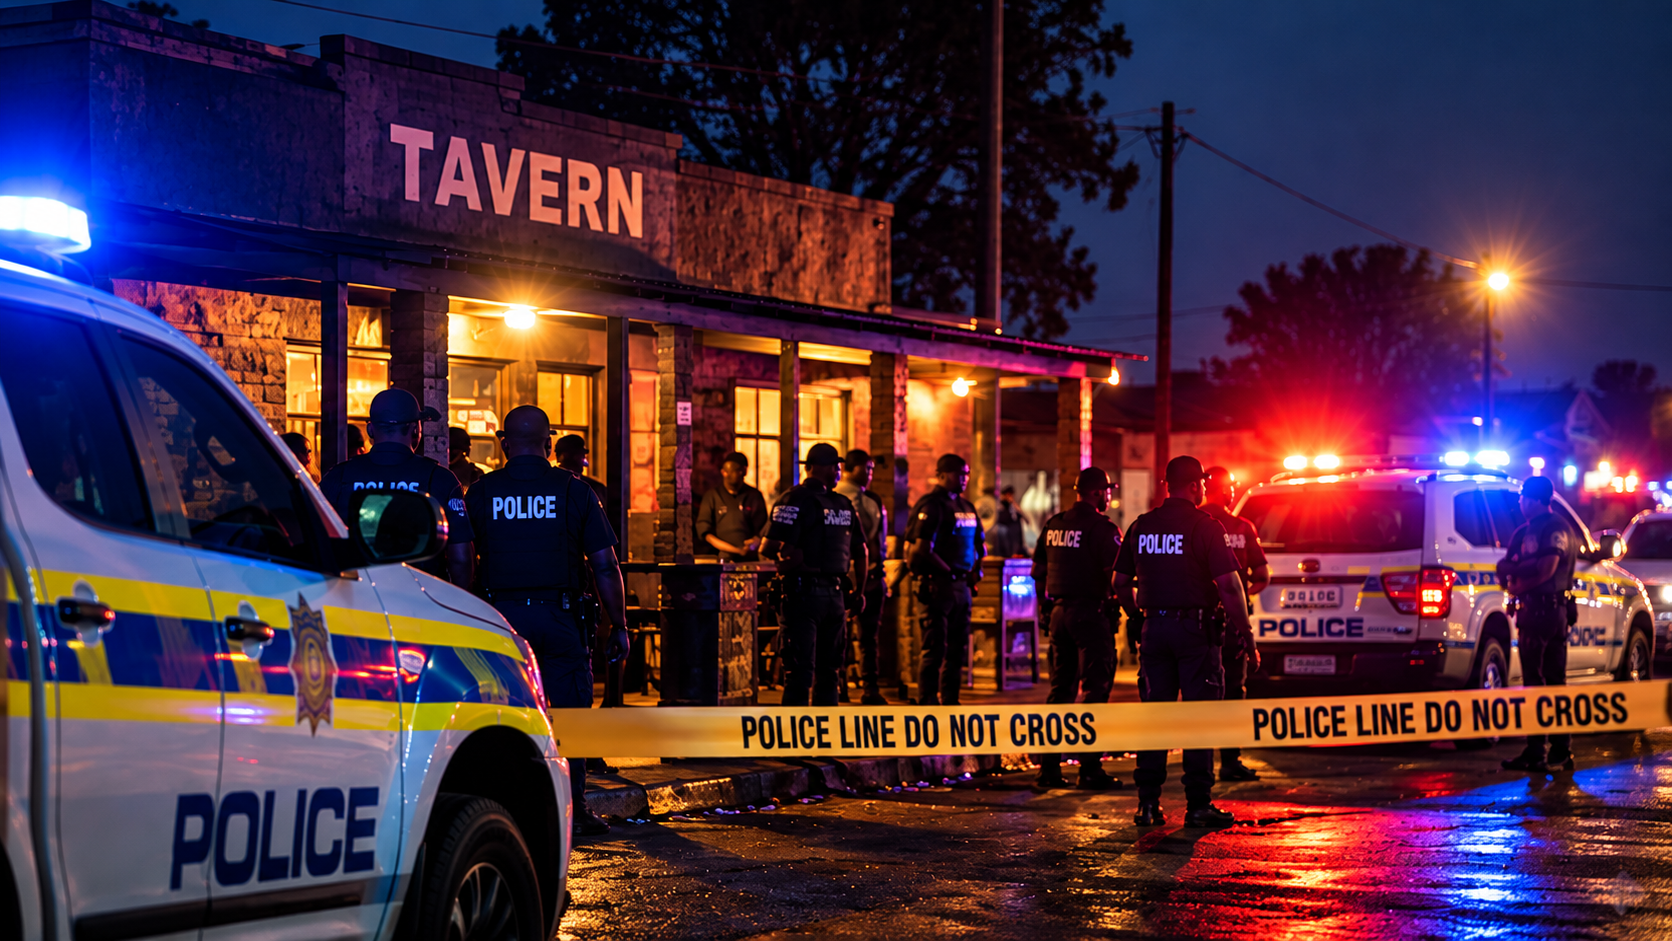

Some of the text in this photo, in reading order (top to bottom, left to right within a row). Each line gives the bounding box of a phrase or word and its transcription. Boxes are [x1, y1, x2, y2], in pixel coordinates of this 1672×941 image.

[390, 123, 643, 239] TAVERN
[492, 495, 557, 520] POLICE
[1046, 529, 1083, 548] POLICE
[1138, 533, 1184, 555] POLICE
[1258, 617, 1364, 638] POLICE
[741, 712, 1097, 749] POLICE LINE DO NOT CROSS
[1252, 692, 1629, 741] POLICE LINE DO NOT CROSS
[169, 786, 380, 892] POLICE
